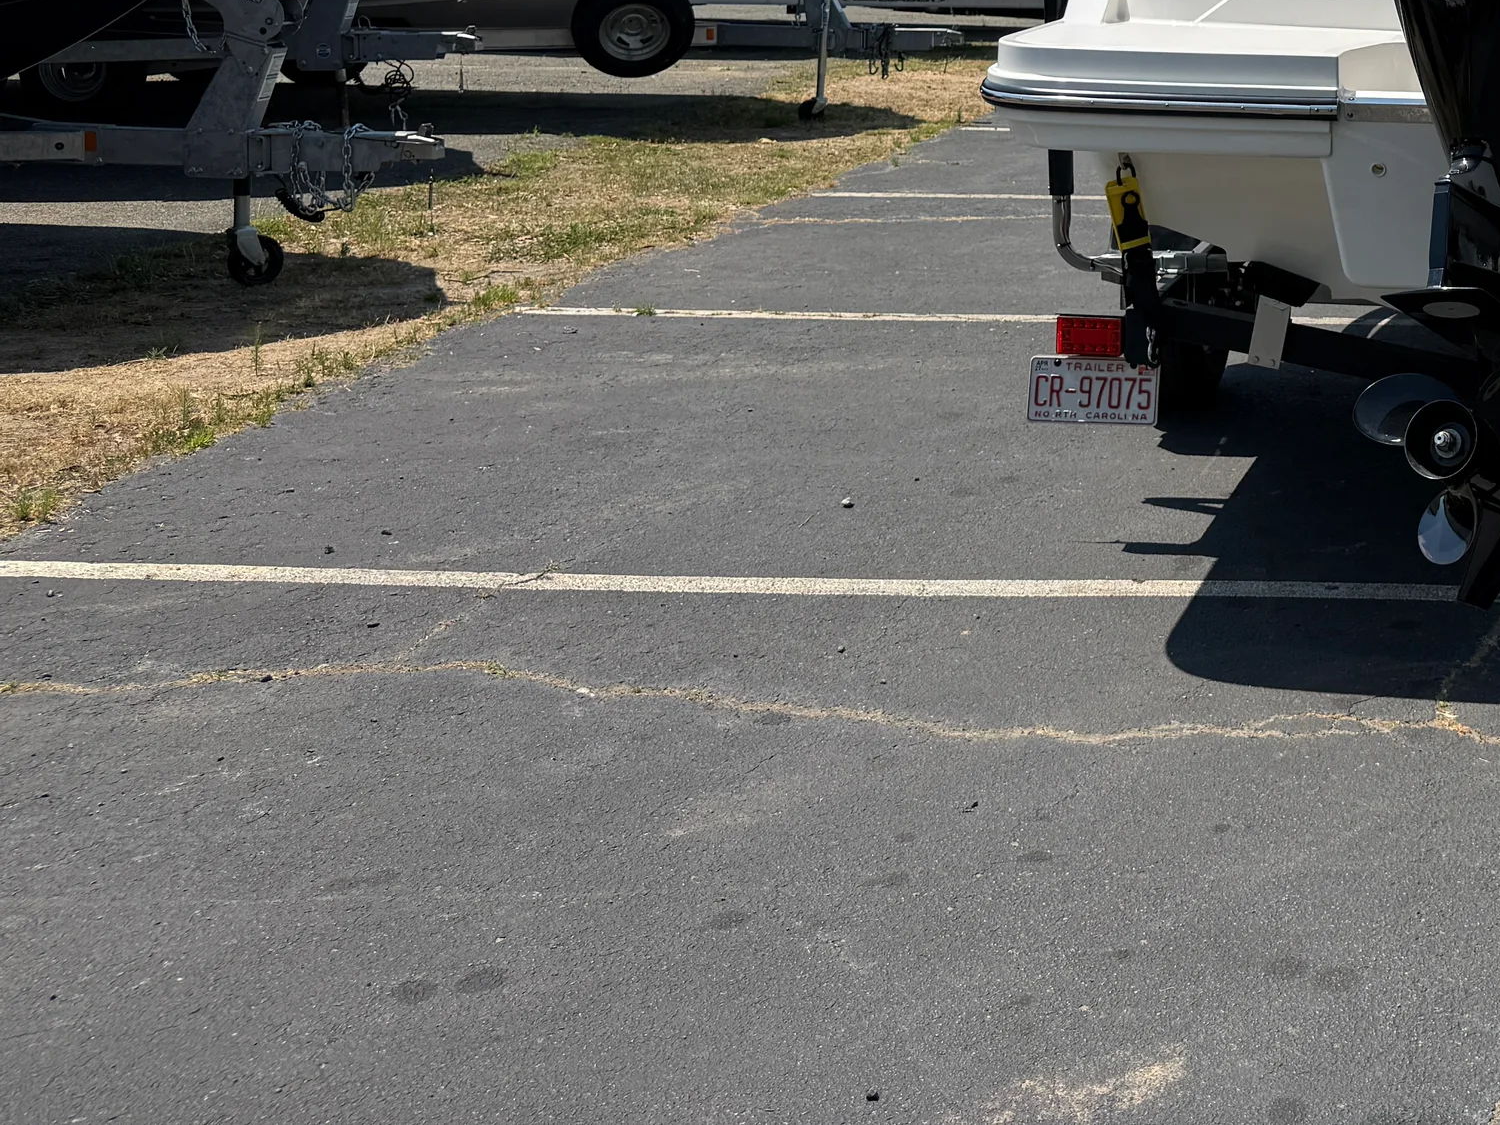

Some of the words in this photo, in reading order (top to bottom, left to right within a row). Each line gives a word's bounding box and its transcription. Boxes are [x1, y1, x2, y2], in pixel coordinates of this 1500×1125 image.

[1066, 362, 1124, 373] TRAILER
[1034, 374, 1152, 410] CR-97075
[1034, 410, 1077, 418] NORTH
[1085, 412, 1148, 421] CAROLINA
